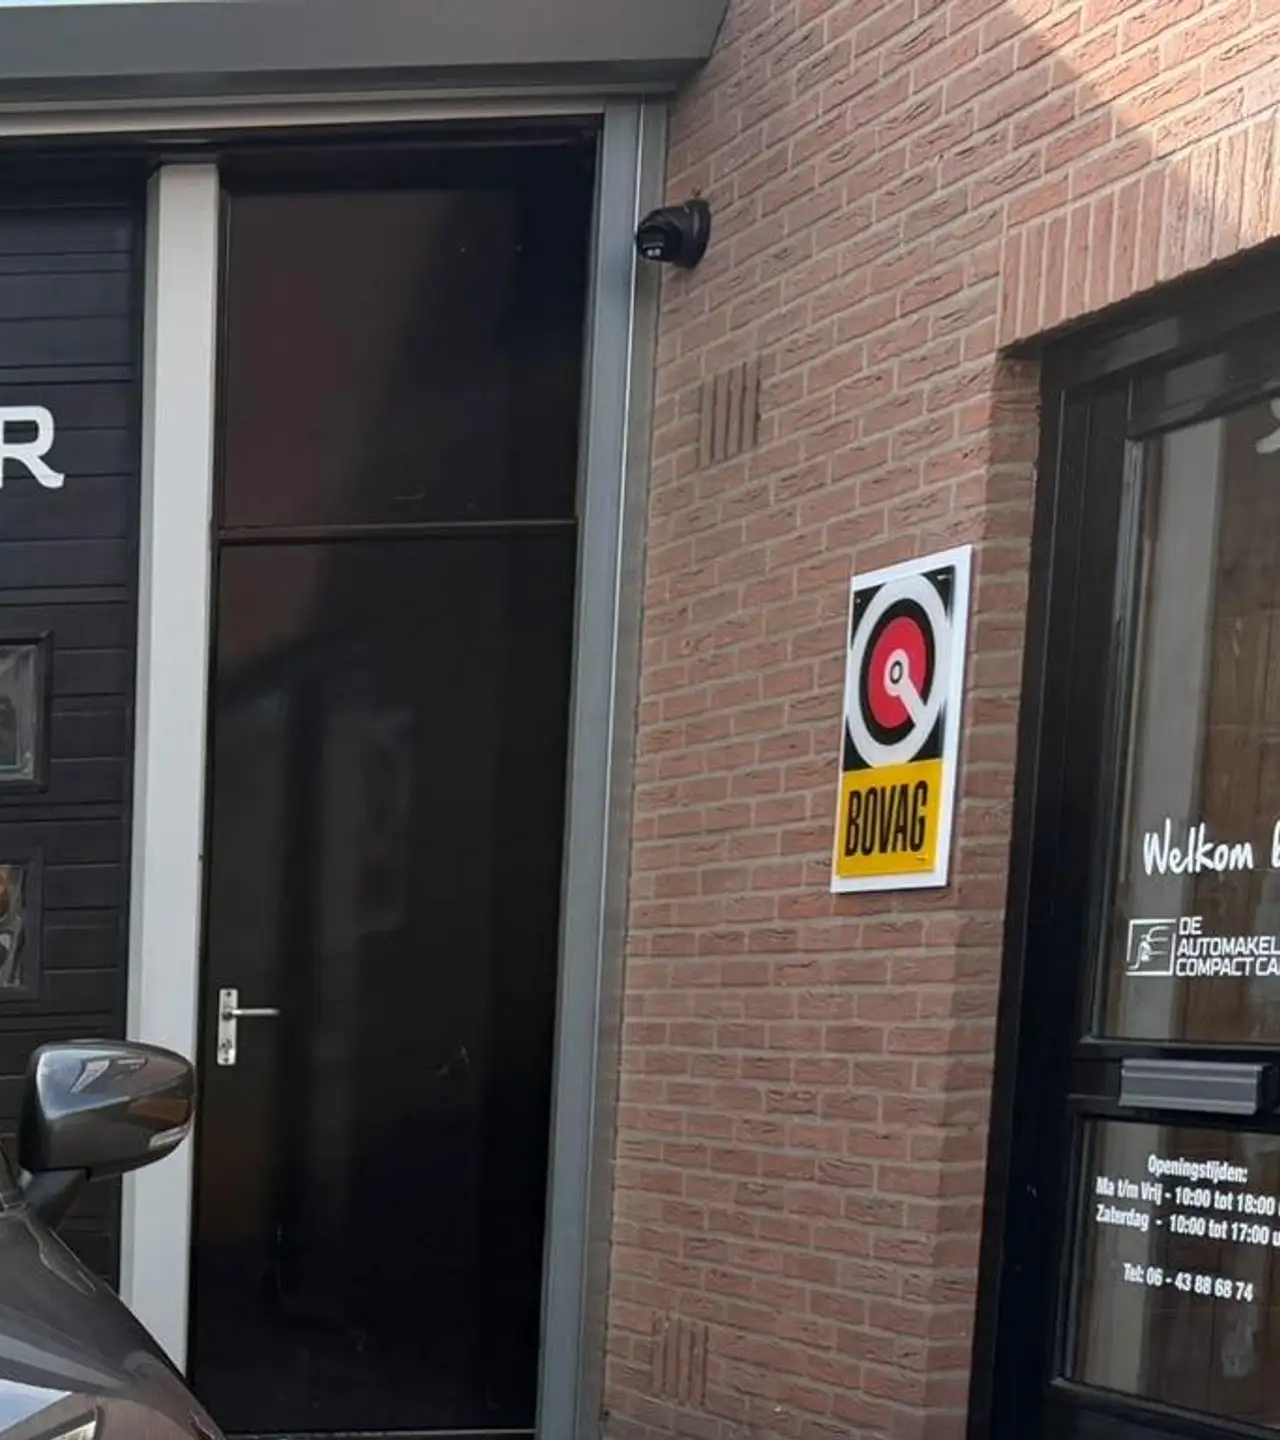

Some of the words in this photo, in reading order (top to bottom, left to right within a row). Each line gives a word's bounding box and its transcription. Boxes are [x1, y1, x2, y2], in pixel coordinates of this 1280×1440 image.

[845, 780, 928, 857] BOVAG
[1143, 817, 1254, 876] Welkom
[1178, 916, 1203, 935] DE
[1176, 957, 1254, 977] COMPACT
[1148, 1153, 1248, 1184] Openingstijden:
[1175, 1186, 1211, 1208] 10:00
[1214, 1190, 1234, 1211] tot
[1237, 1193, 1276, 1217] 18:00
[1096, 1204, 1149, 1232] Zaterdag
[1170, 1213, 1206, 1236] 10:00
[1208, 1218, 1228, 1240] tot
[1231, 1221, 1269, 1245] 17:00
